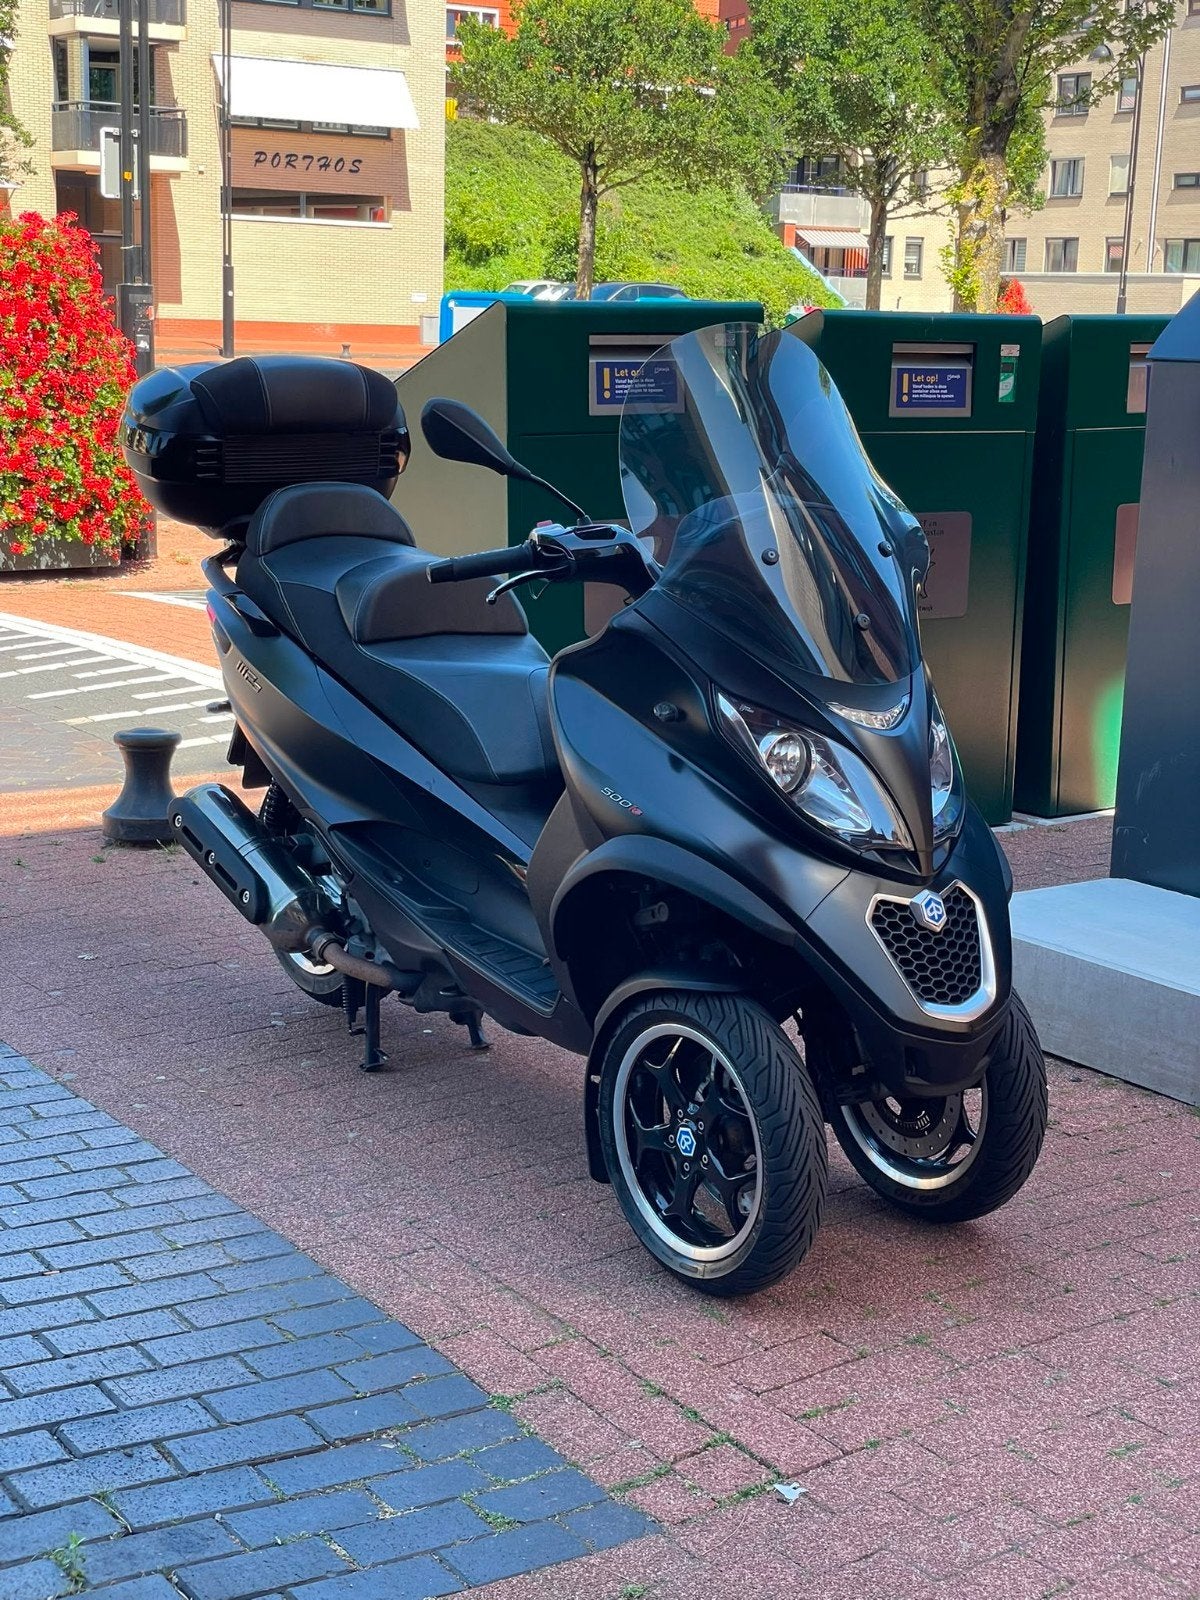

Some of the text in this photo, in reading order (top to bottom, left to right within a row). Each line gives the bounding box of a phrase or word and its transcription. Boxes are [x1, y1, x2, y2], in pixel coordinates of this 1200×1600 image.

[254, 151, 363, 173] PORTHOS
[614, 367, 628, 377] Let
[912, 373, 938, 384] Let op!
[600, 787, 632, 808] 500
